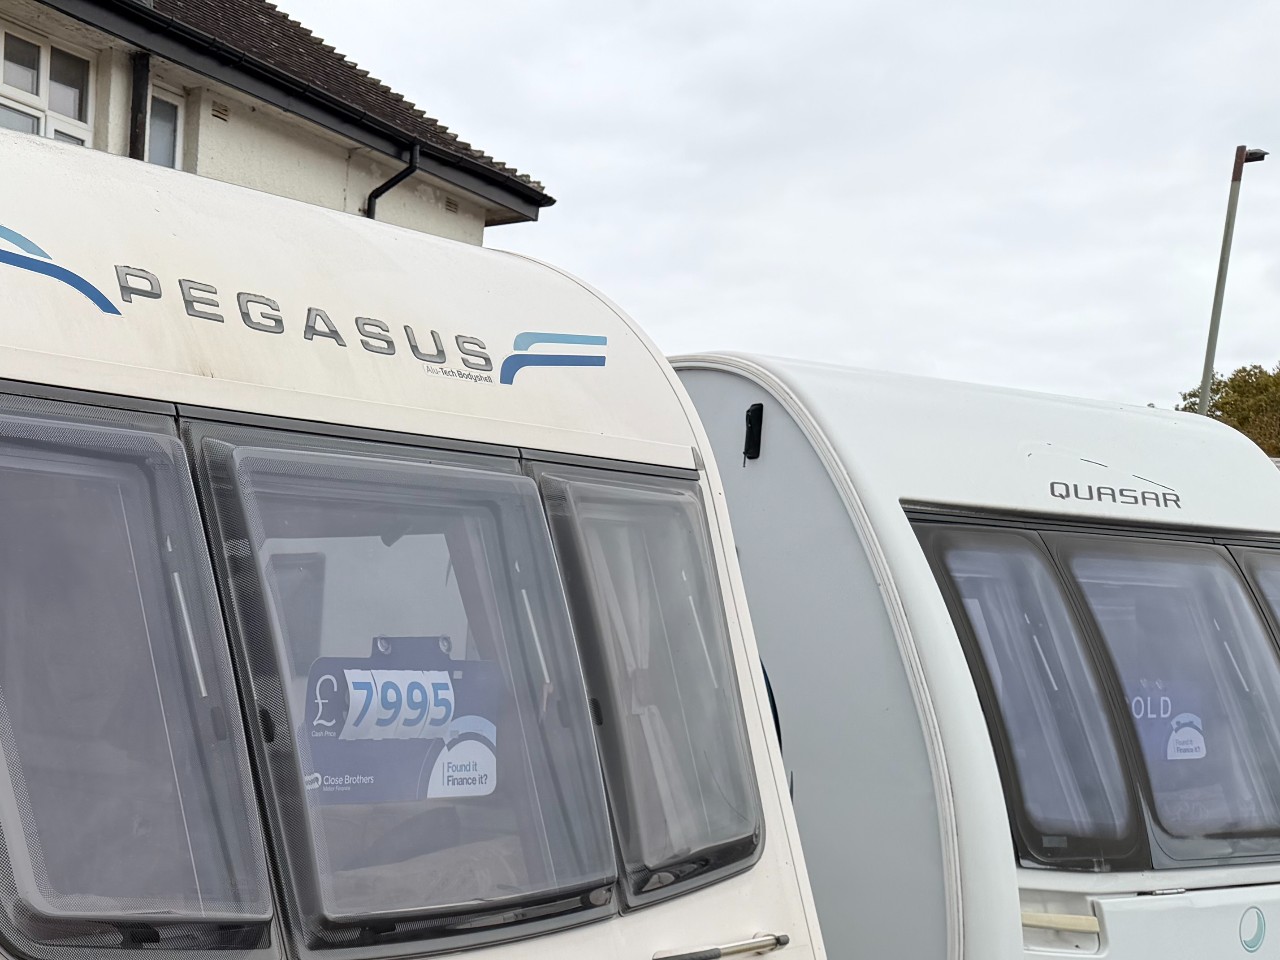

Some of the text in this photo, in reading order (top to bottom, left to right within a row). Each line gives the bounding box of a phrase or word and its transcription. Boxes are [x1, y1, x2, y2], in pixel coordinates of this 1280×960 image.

[114, 264, 494, 372] PEGASUS
[426, 365, 493, 383] Alu-Tech Bodyshell
[1049, 481, 1182, 509] QUASAR
[1125, 696, 1171, 719] OLD
[447, 761, 478, 773] Found it
[323, 774, 374, 785] Close Brothers
[447, 774, 488, 787] Finance it?
